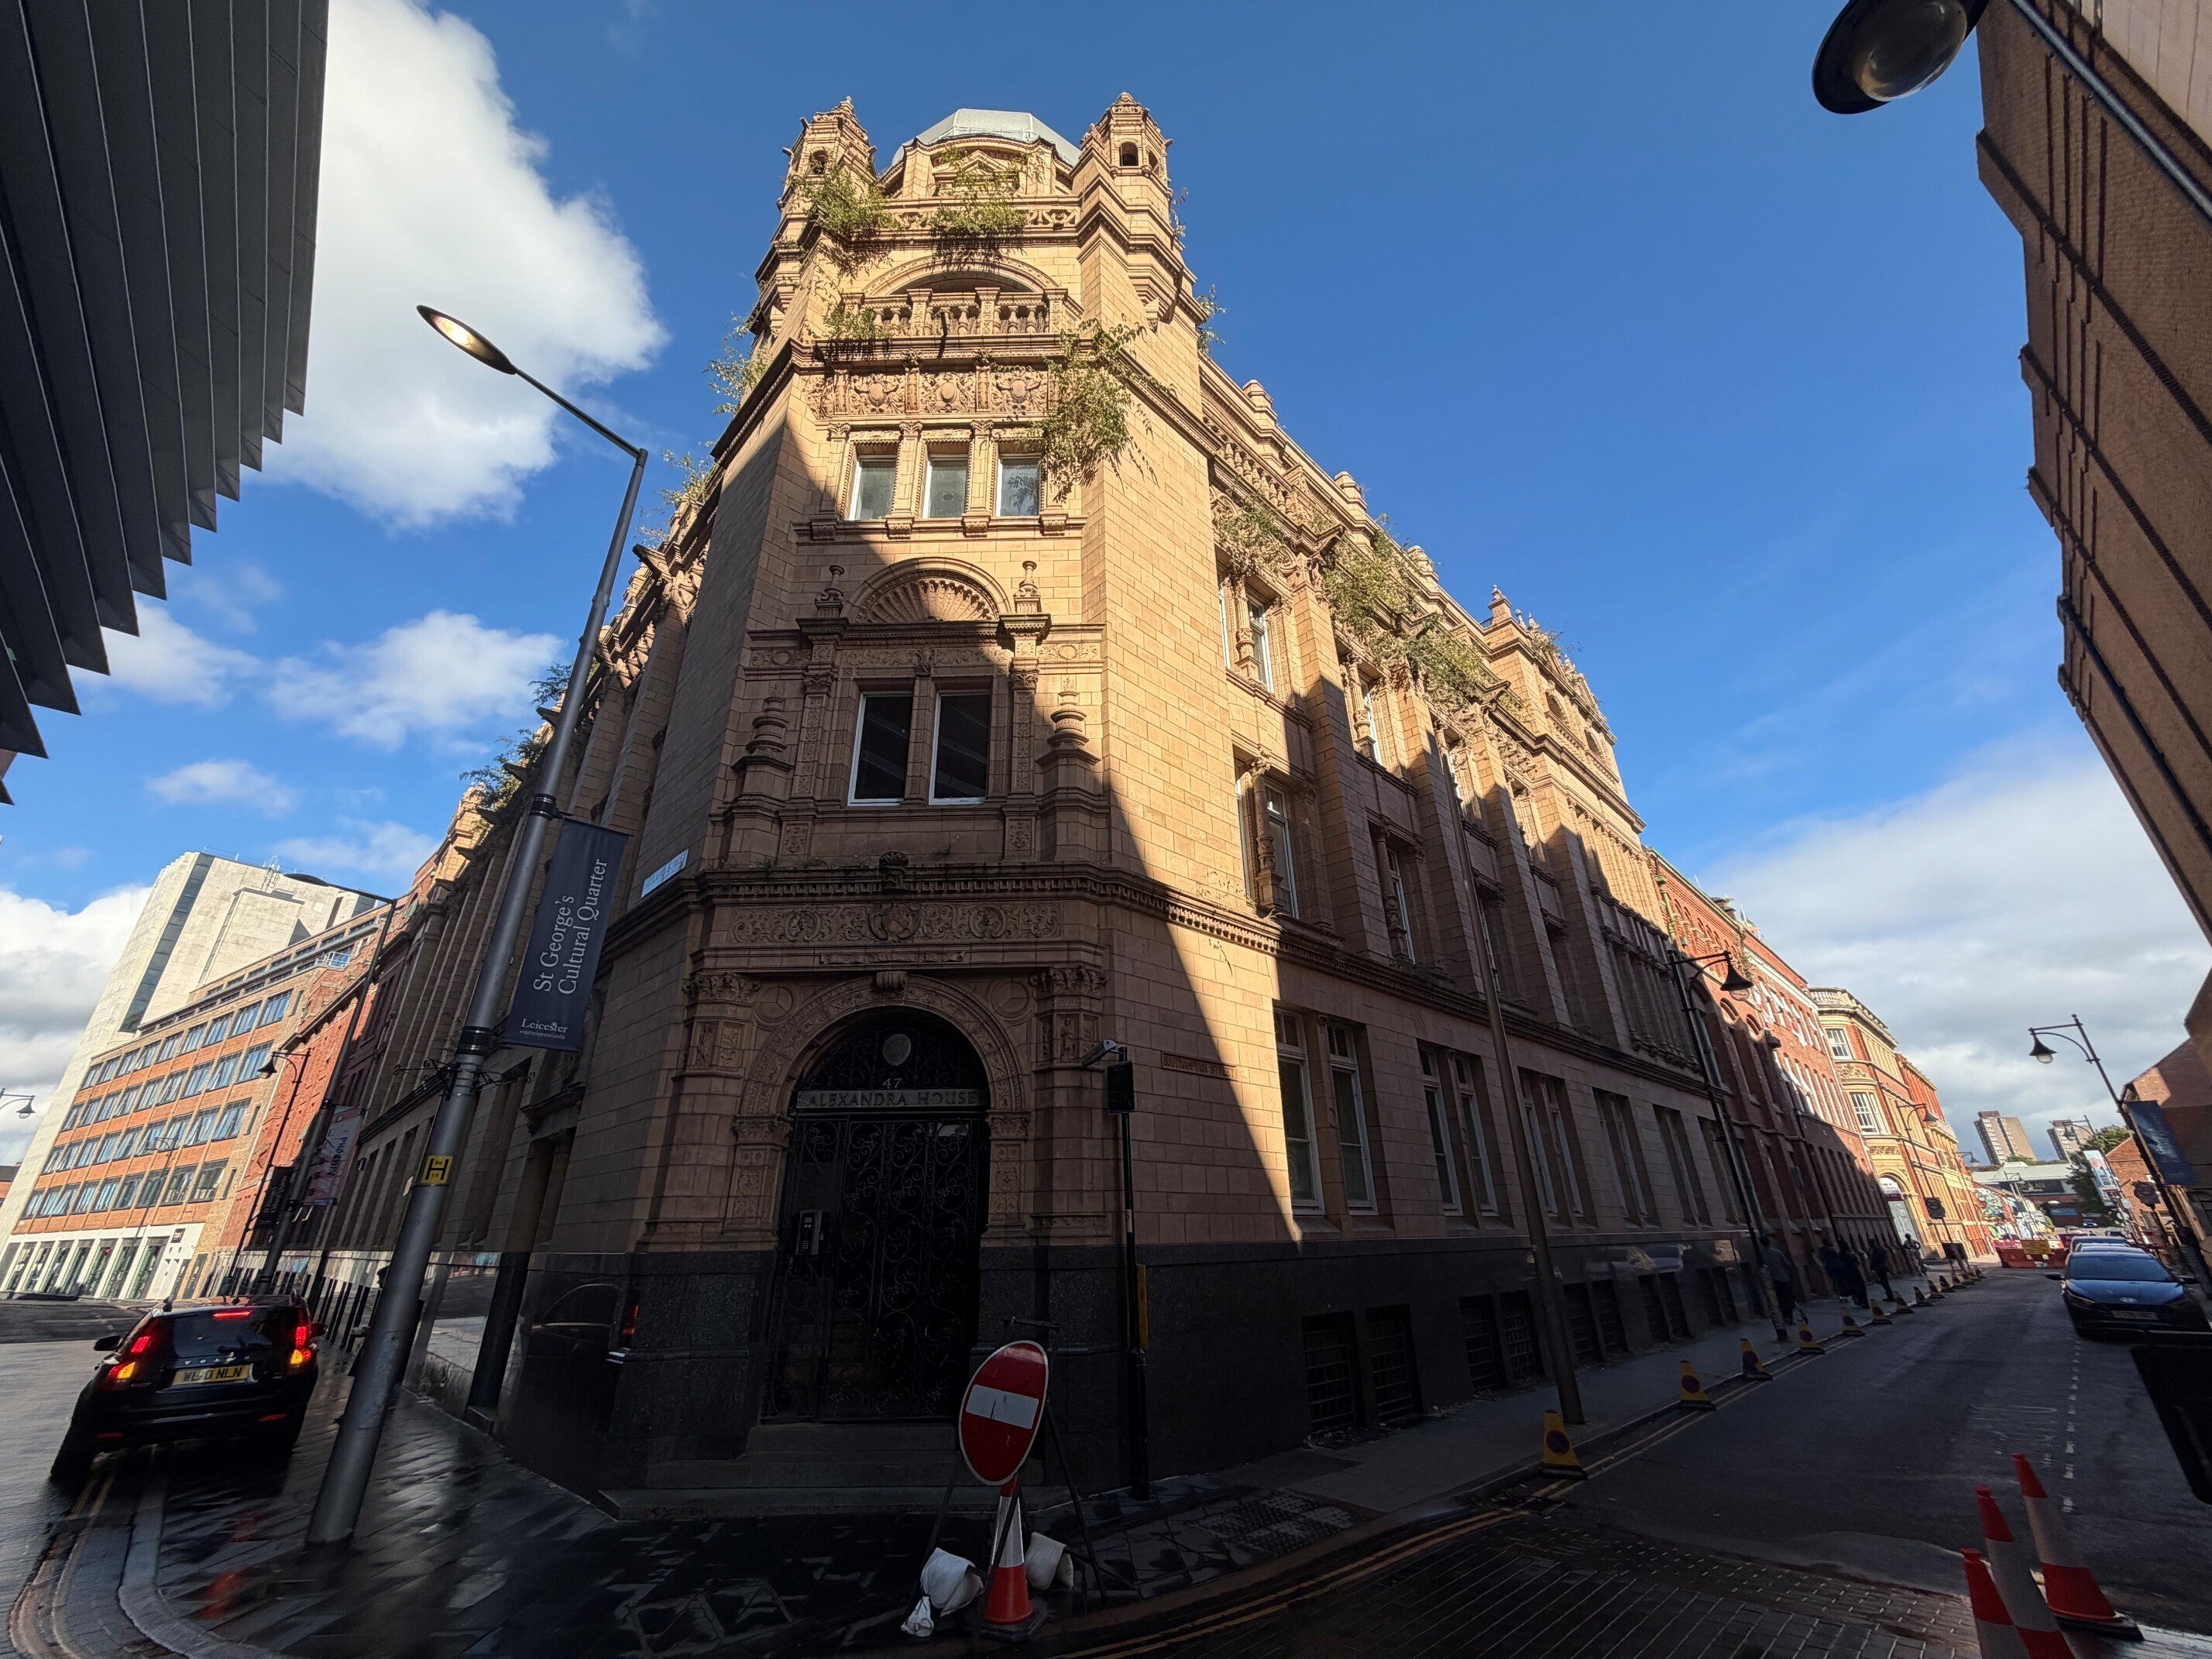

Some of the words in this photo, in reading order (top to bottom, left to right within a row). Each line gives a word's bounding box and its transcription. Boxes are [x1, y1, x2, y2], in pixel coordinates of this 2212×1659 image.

[540, 895, 575, 967] George's
[558, 926, 591, 994] Cultural
[577, 859, 607, 921] Quarter
[533, 971, 554, 992] St
[521, 1018, 568, 1033] Leicester
[882, 1077, 902, 1089] 47
[810, 1092, 908, 1107] ALEXANDRA
[917, 1091, 981, 1106] HOUSE
[424, 1157, 449, 1180] H
[184, 1369, 214, 1382] WL0
